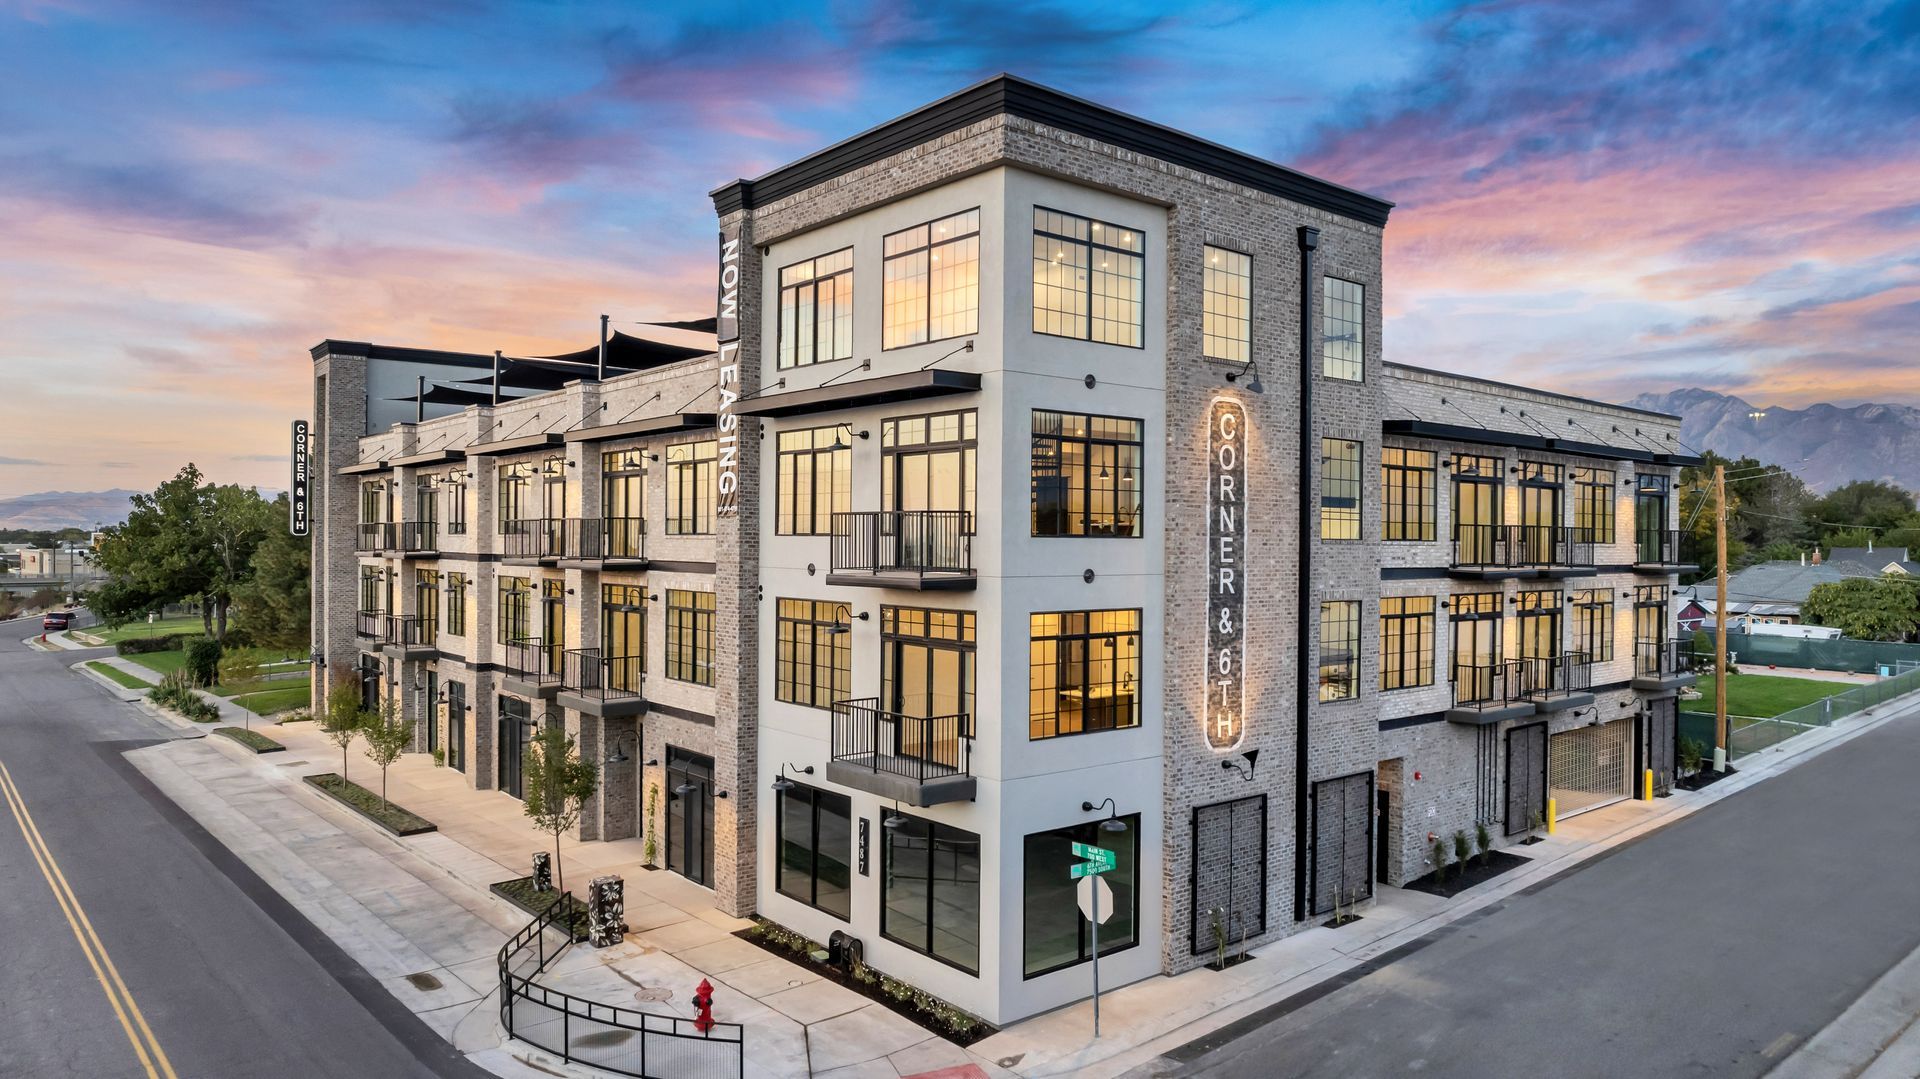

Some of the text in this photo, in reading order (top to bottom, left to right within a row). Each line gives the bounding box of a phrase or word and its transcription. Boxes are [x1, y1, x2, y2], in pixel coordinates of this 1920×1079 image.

[721, 239, 738, 318] NOW
[296, 424, 305, 530] CORNER & 6TH
[719, 343, 739, 494] LEASING
[1217, 413, 1236, 738] CORNER & 6TH
